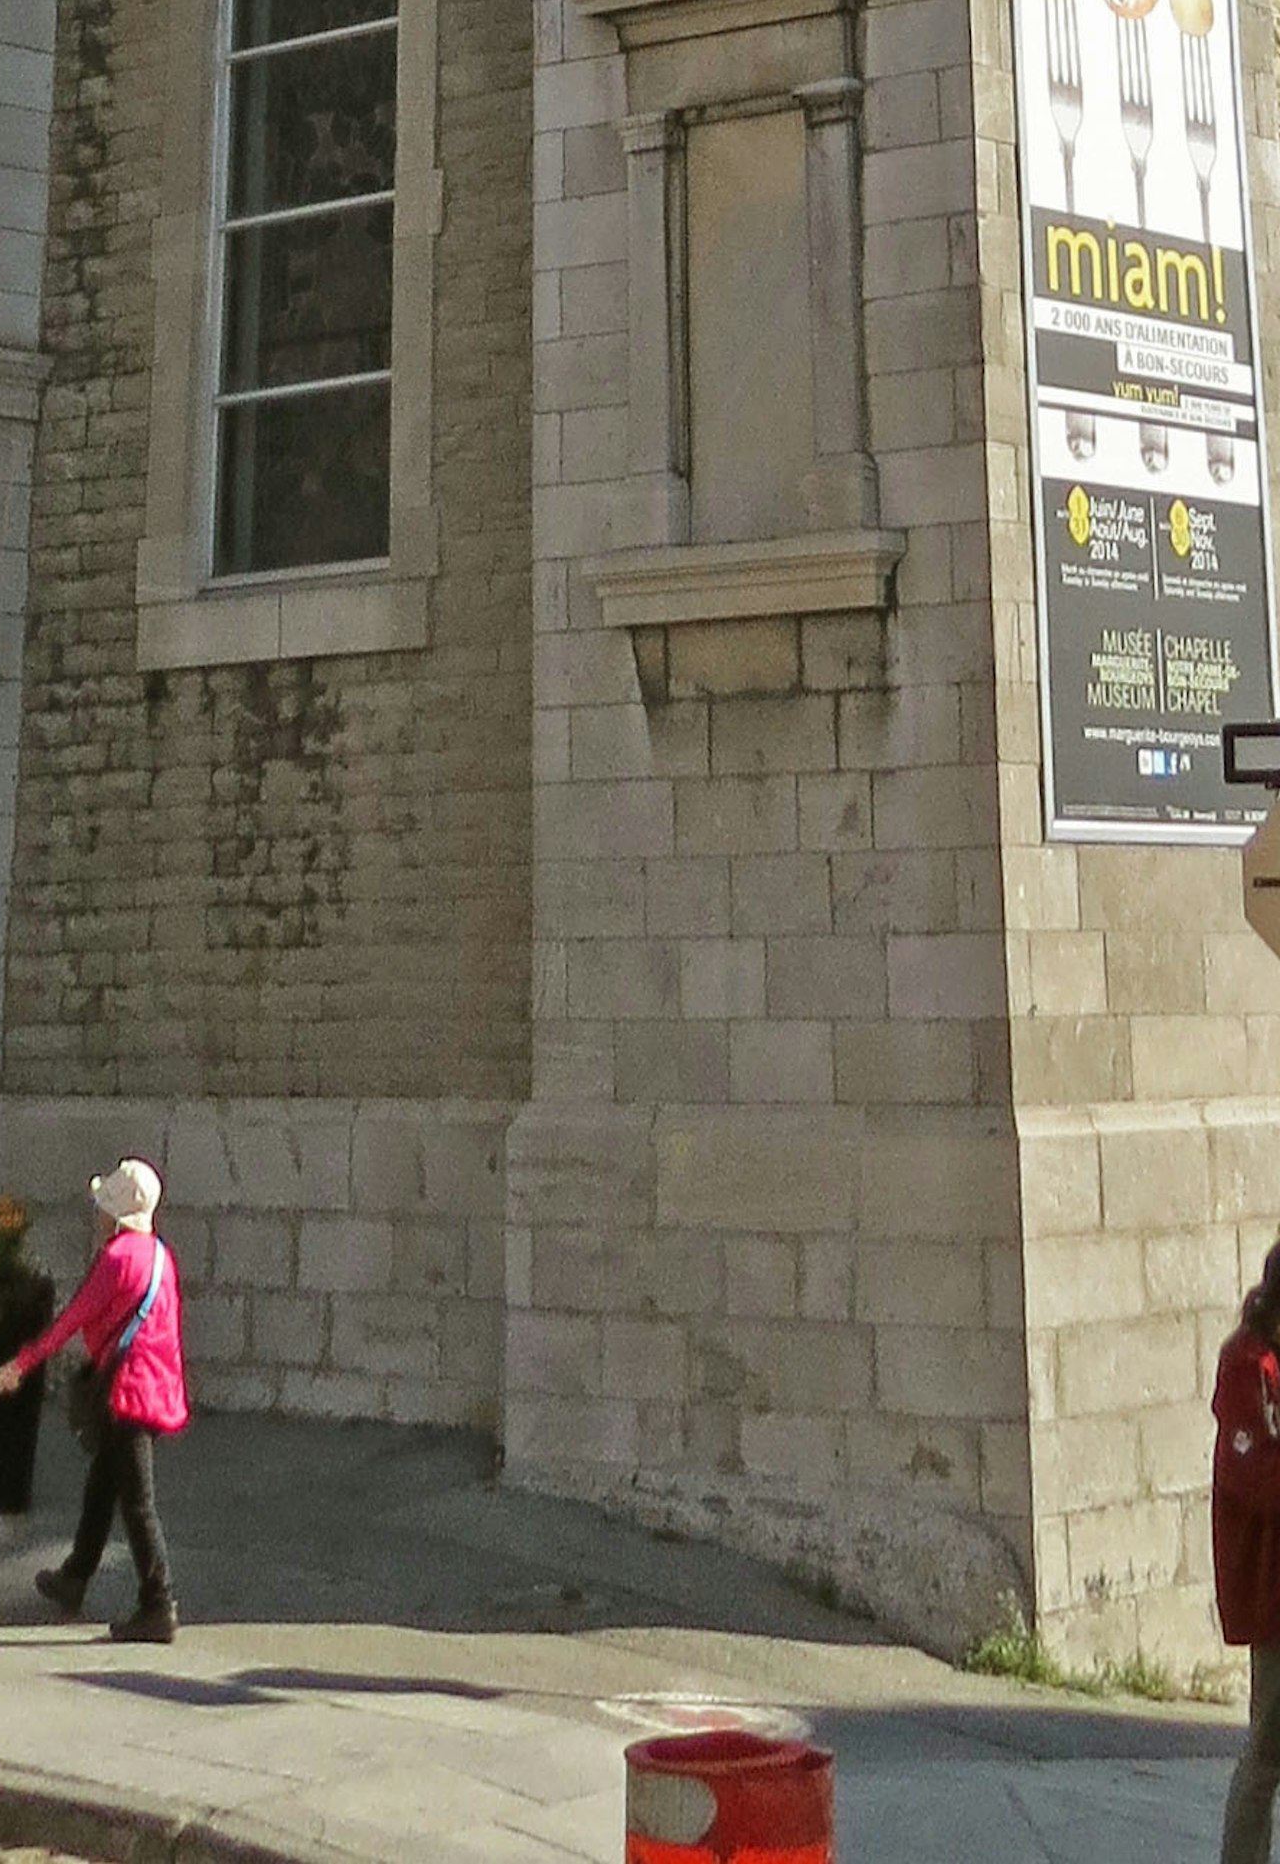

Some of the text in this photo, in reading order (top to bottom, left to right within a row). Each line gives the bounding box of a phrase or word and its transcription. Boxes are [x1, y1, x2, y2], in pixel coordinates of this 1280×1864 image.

[1047, 216, 1226, 324] miam!
[1051, 307, 1228, 358] 2 000 ANS D'ALIMENTATION
[1137, 352, 1229, 385] BON-SECOURS
[1112, 381, 1179, 407] yum yum!
[1089, 496, 1144, 523] Juin/June
[1189, 507, 1216, 534] Sept.
[1089, 517, 1149, 549] Août/Aug.
[1191, 530, 1215, 550] Nov.
[1089, 540, 1120, 561] 2014
[1191, 551, 1219, 571] 2014
[1103, 628, 1152, 656] MUSÉE
[1164, 635, 1232, 663] CHAPELLE
[1087, 683, 1155, 709] MUSEUM
[1167, 689, 1221, 715] CHAPEL
